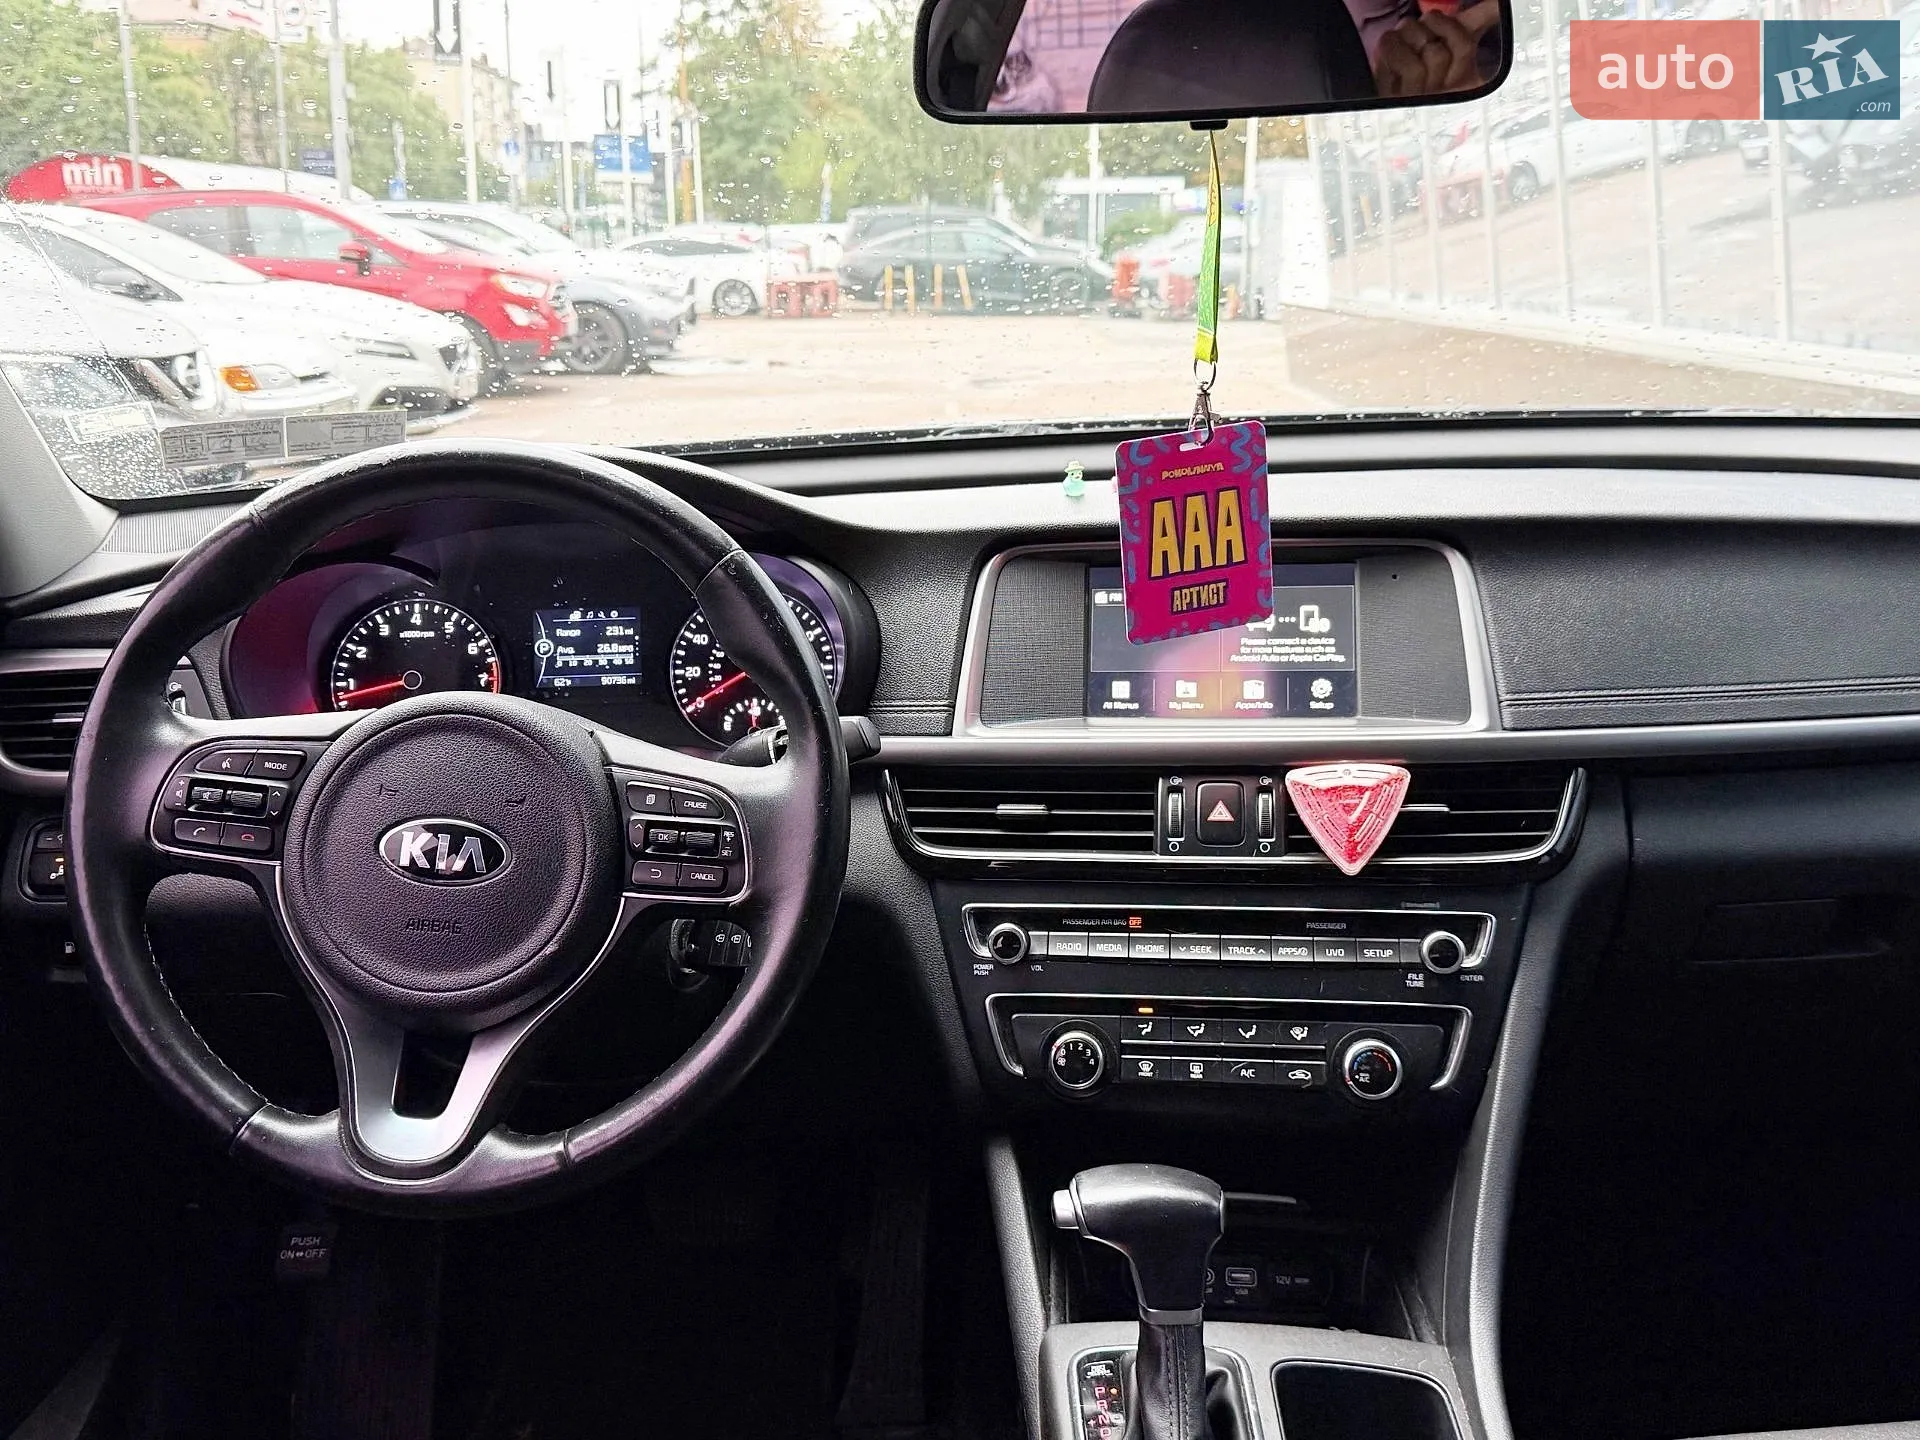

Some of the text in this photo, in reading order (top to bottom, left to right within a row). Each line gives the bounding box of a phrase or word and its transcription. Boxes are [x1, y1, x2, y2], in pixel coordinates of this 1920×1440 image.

[1150, 489, 1245, 577] AAA
[1172, 581, 1226, 612] АРТИСТ
[411, 613, 422, 625] 4
[379, 624, 389, 636] 3
[444, 622, 454, 633] 5
[692, 634, 708, 645] 40
[356, 646, 367, 658] 2
[467, 643, 478, 654] 6
[540, 643, 549, 653] P
[685, 667, 701, 678] 20
[348, 678, 354, 690] 1
[1310, 701, 1334, 710] Setup
[264, 761, 288, 770] MODE
[684, 800, 708, 809] CRUISE
[658, 833, 668, 841] OK
[399, 831, 486, 873] KIA
[690, 872, 717, 881] CANCEL
[404, 917, 463, 934] AIRBAG
[1062, 918, 1100, 926] PASSENGER
[1101, 918, 1112, 926] AIR
[1129, 918, 1142, 926] OFF
[1306, 922, 1347, 930] PASSENGER
[1056, 942, 1082, 951] RADIO
[1096, 943, 1122, 952] MEDIA
[1135, 944, 1165, 953] PHONE
[1189, 945, 1212, 954] SEEK
[1228, 947, 1256, 955] TRACK
[1325, 948, 1345, 957] UVO
[1363, 949, 1393, 958] SETUP
[1030, 964, 1044, 972] VOL
[1240, 1068, 1256, 1078] A/C
[290, 1236, 321, 1246] PUSH
[1095, 1386, 1105, 1399] P
[1096, 1400, 1107, 1411] R
[1098, 1414, 1110, 1425] N
